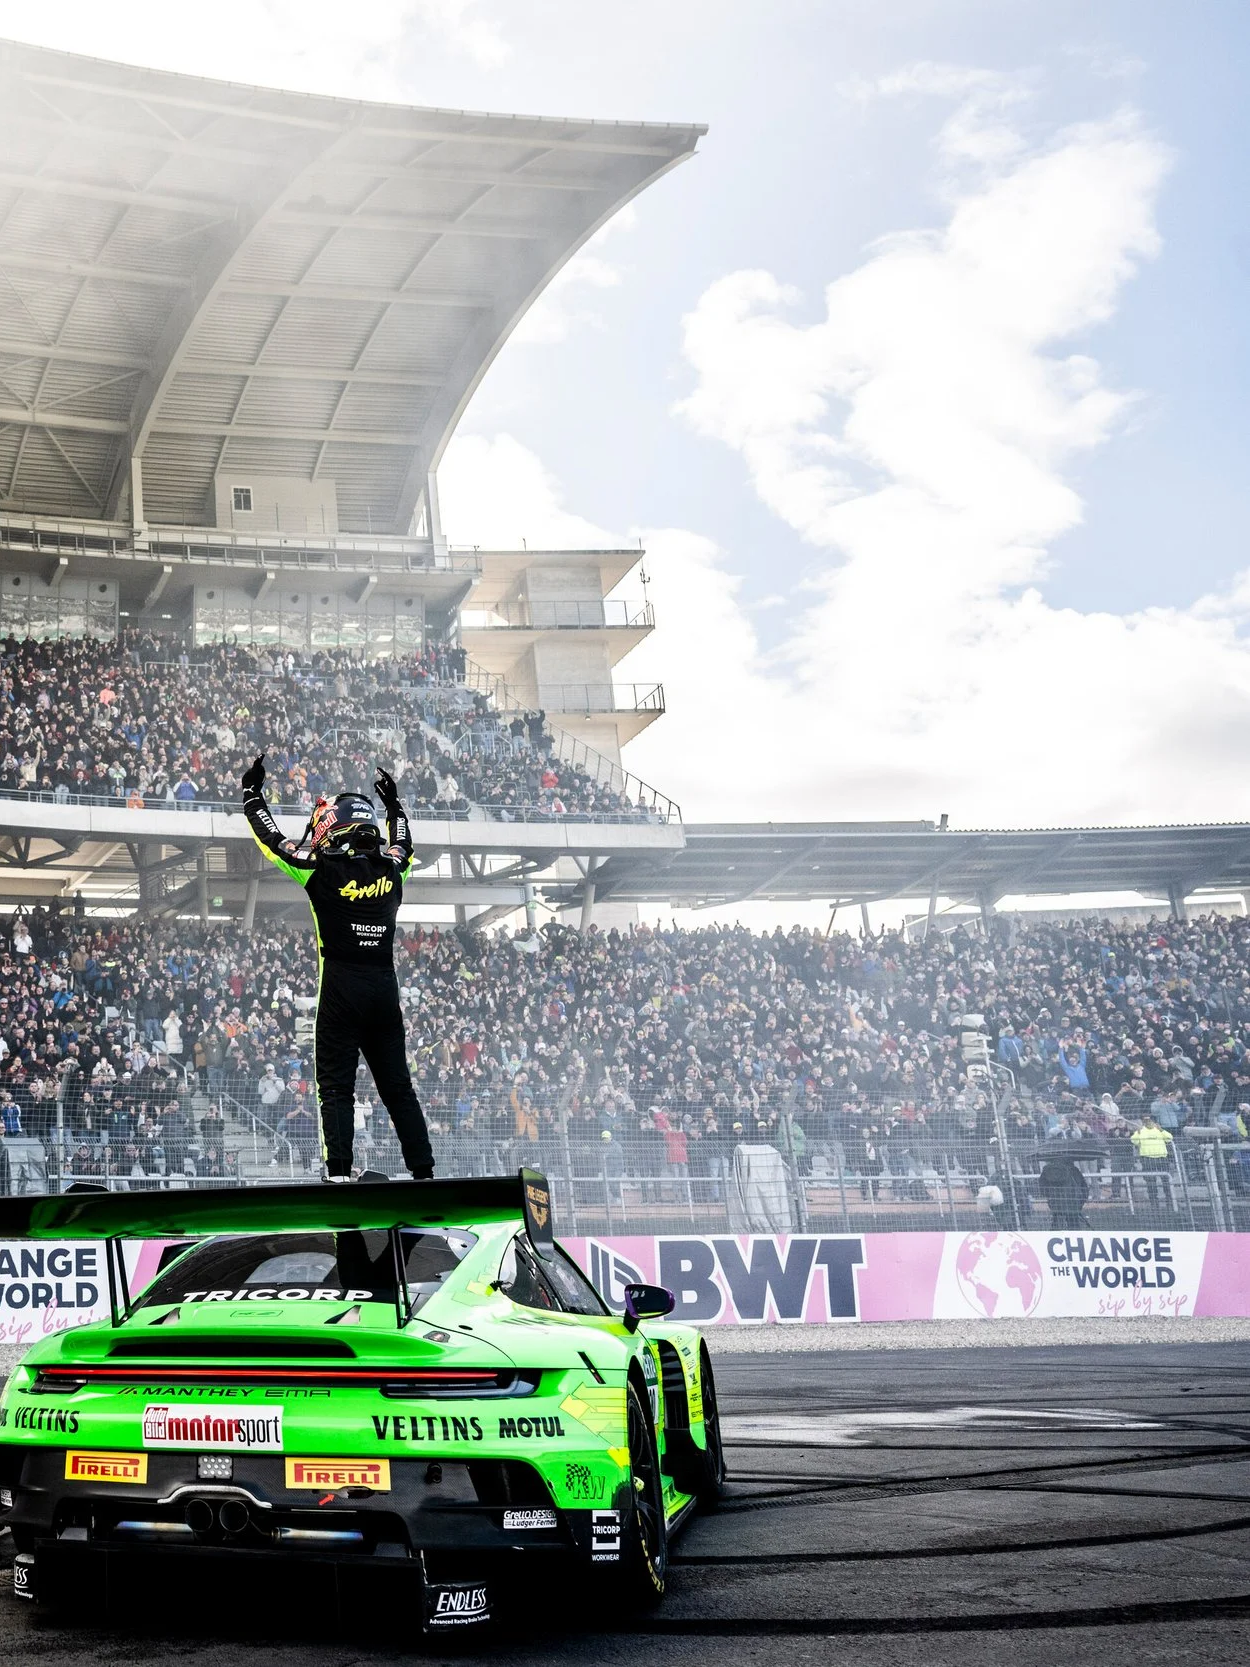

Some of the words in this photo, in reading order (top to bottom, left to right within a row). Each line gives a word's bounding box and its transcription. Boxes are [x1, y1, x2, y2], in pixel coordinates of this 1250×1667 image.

[256, 808, 279, 834] VELTIN
[338, 875, 393, 902] Grello
[350, 923, 387, 933] TRICORP
[1047, 1237, 1173, 1263] CHANGE
[657, 1238, 865, 1321] BWT
[1050, 1266, 1071, 1277] THE
[1072, 1266, 1176, 1289] WORLD
[181, 1288, 374, 1303] TRICORP
[1098, 1293, 1126, 1317] sip
[1132, 1279, 1152, 1316] by
[1158, 1290, 1188, 1317] sip
[142, 1387, 255, 1398] MANTHEY
[264, 1388, 332, 1399] EMA
[14, 1406, 81, 1434] VELTINS
[145, 1407, 168, 1422] Auto
[145, 1422, 166, 1439] Bild
[371, 1415, 484, 1442] VELTINS
[499, 1416, 566, 1439] MOTUL
[72, 1455, 140, 1478] PIRELLI
[294, 1463, 381, 1485] PIRELLI
[572, 1475, 606, 1500] KW
[592, 1525, 621, 1535] TRICORP
[592, 1553, 620, 1562] WORKWEAR
[436, 1587, 487, 1612] ENDLESS
